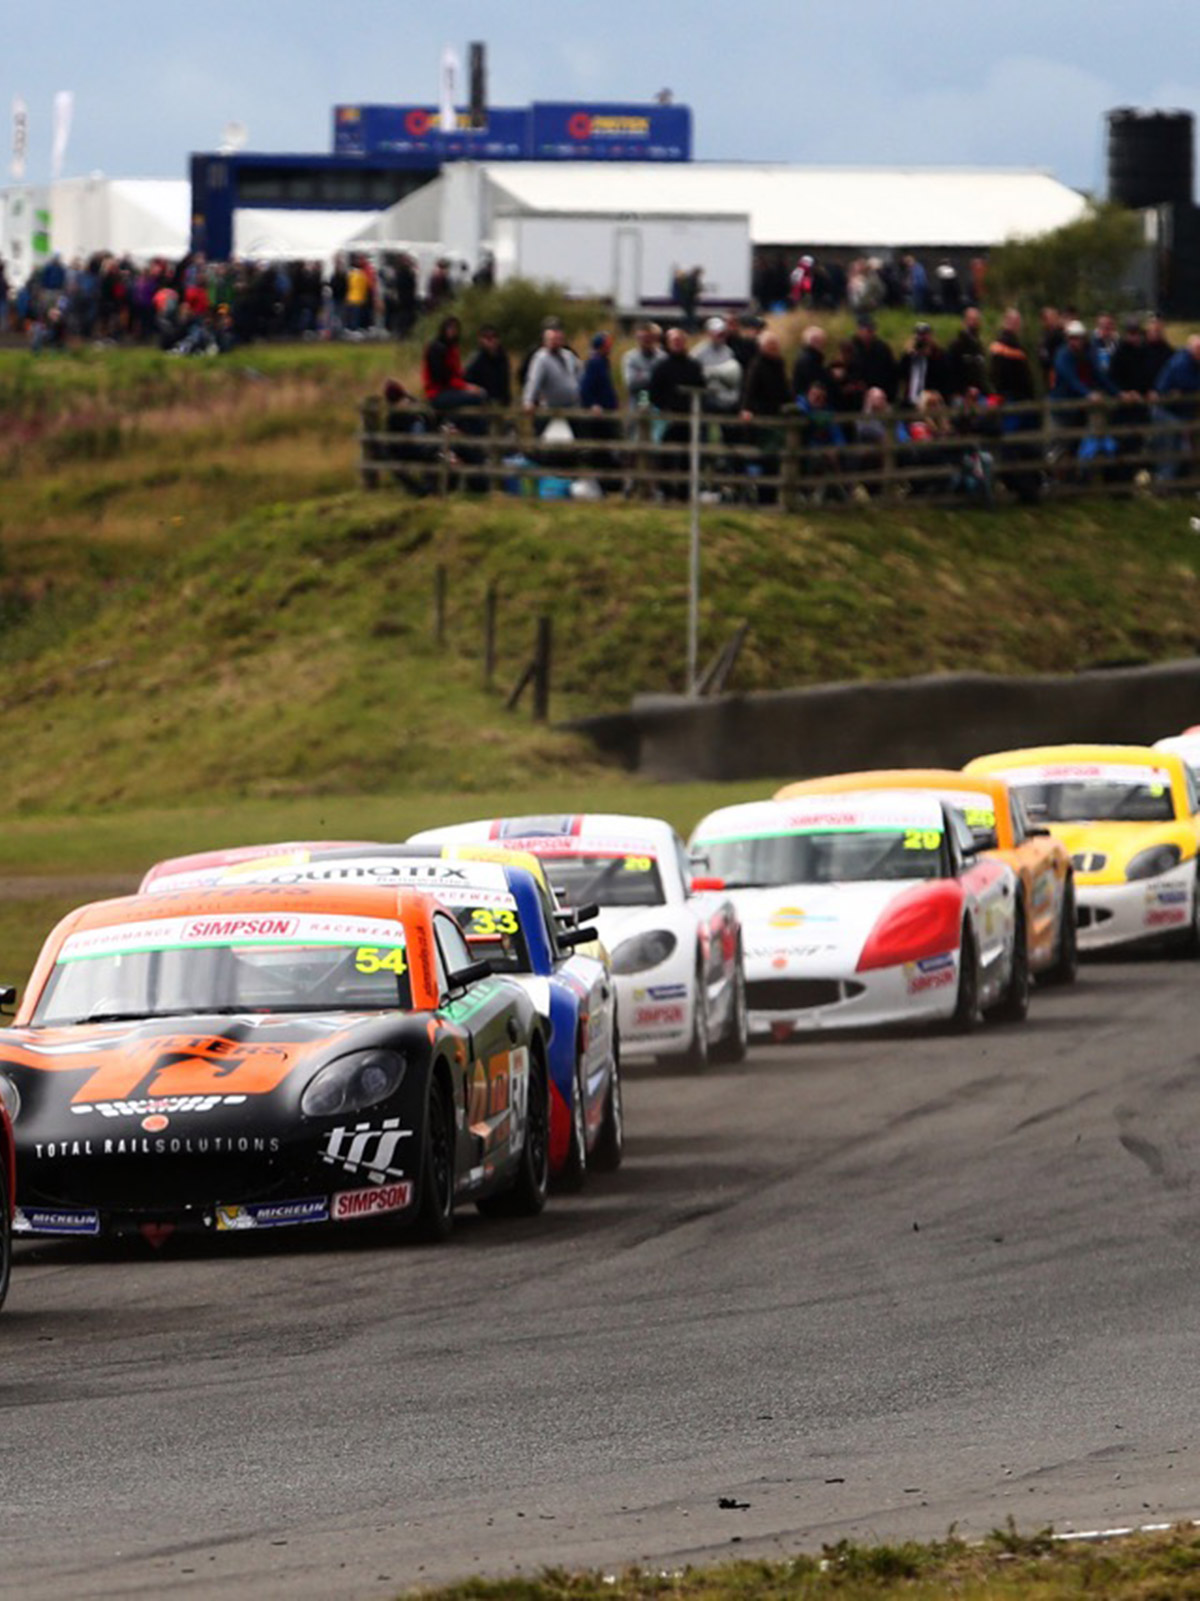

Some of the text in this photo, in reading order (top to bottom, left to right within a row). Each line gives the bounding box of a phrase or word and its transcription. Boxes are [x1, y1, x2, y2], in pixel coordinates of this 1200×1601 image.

[65, 918, 405, 950] PERFORMANCE SIMPSON RACEWEAR
[471, 908, 519, 935] 33
[354, 946, 407, 975] 54
[36, 1139, 93, 1159] TOTAL
[257, 1202, 325, 1219] MICHELIN
[338, 1185, 409, 1217] SIMPSON
[32, 1212, 97, 1227] MICHELIN
